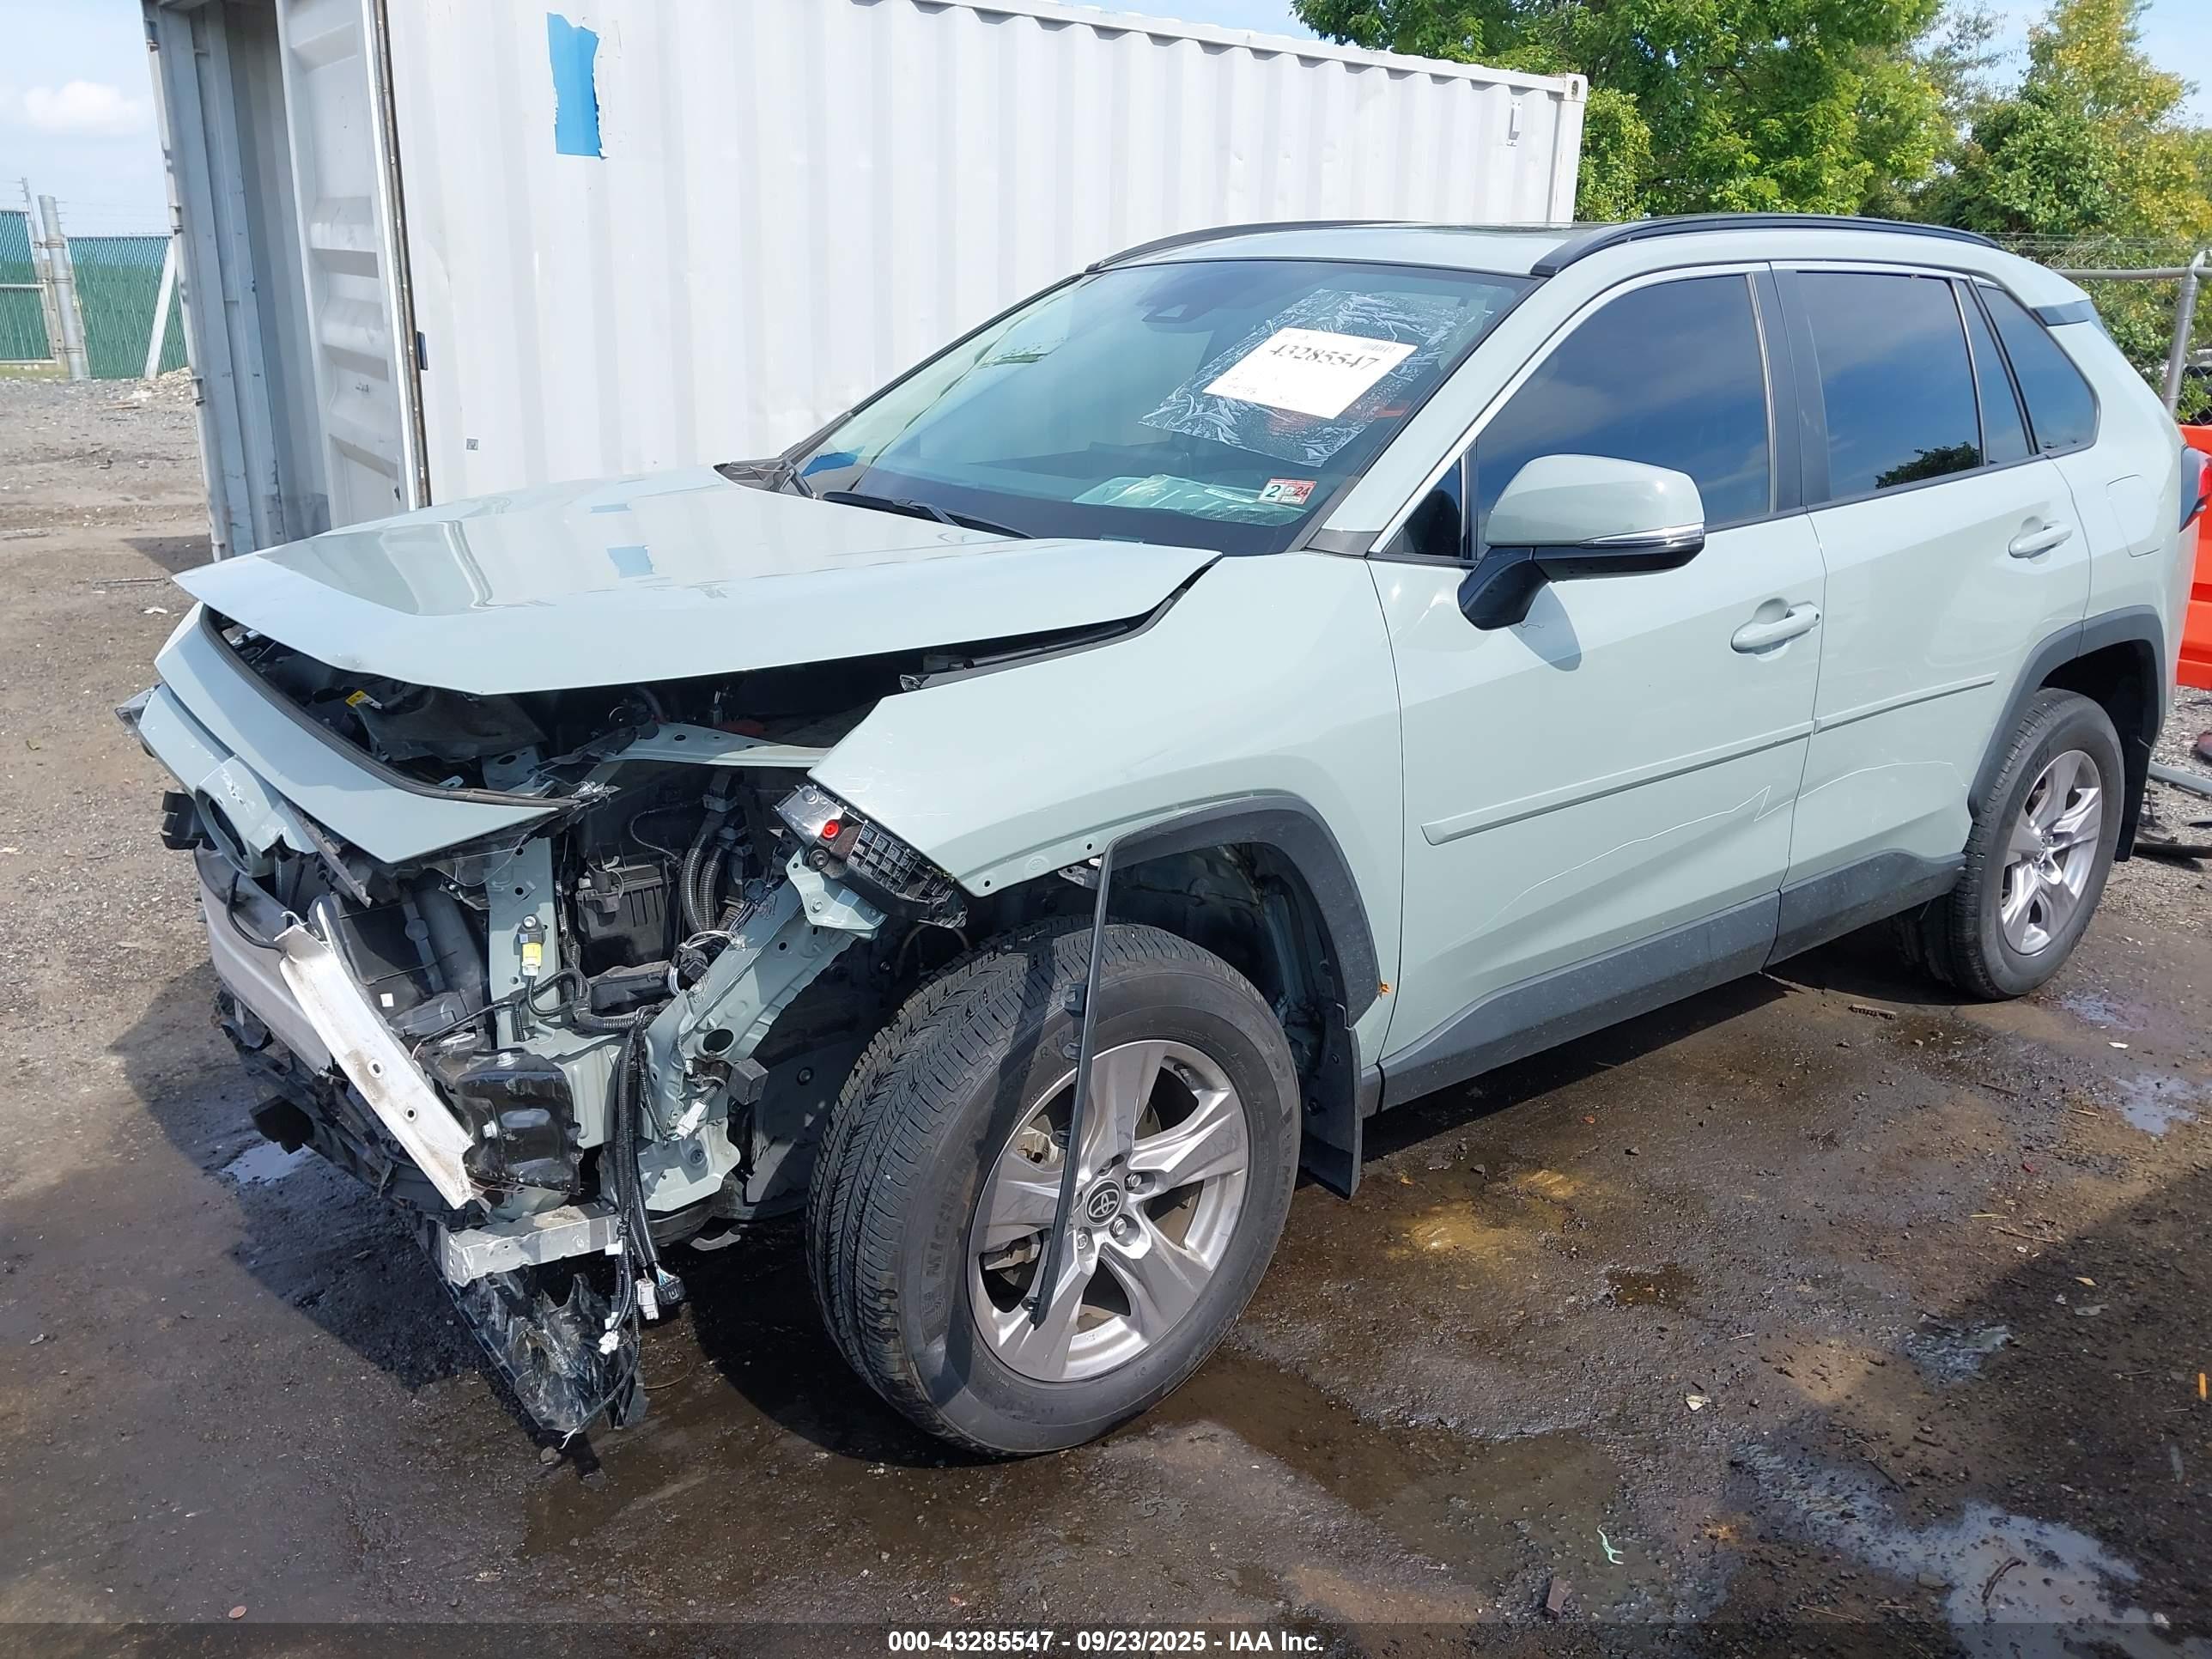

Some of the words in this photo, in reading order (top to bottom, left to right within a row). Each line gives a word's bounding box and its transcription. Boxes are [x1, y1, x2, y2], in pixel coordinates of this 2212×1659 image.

[1269, 343, 1380, 370] 43285547
[1265, 484, 1281, 498] 2
[1294, 486, 1310, 498] 24
